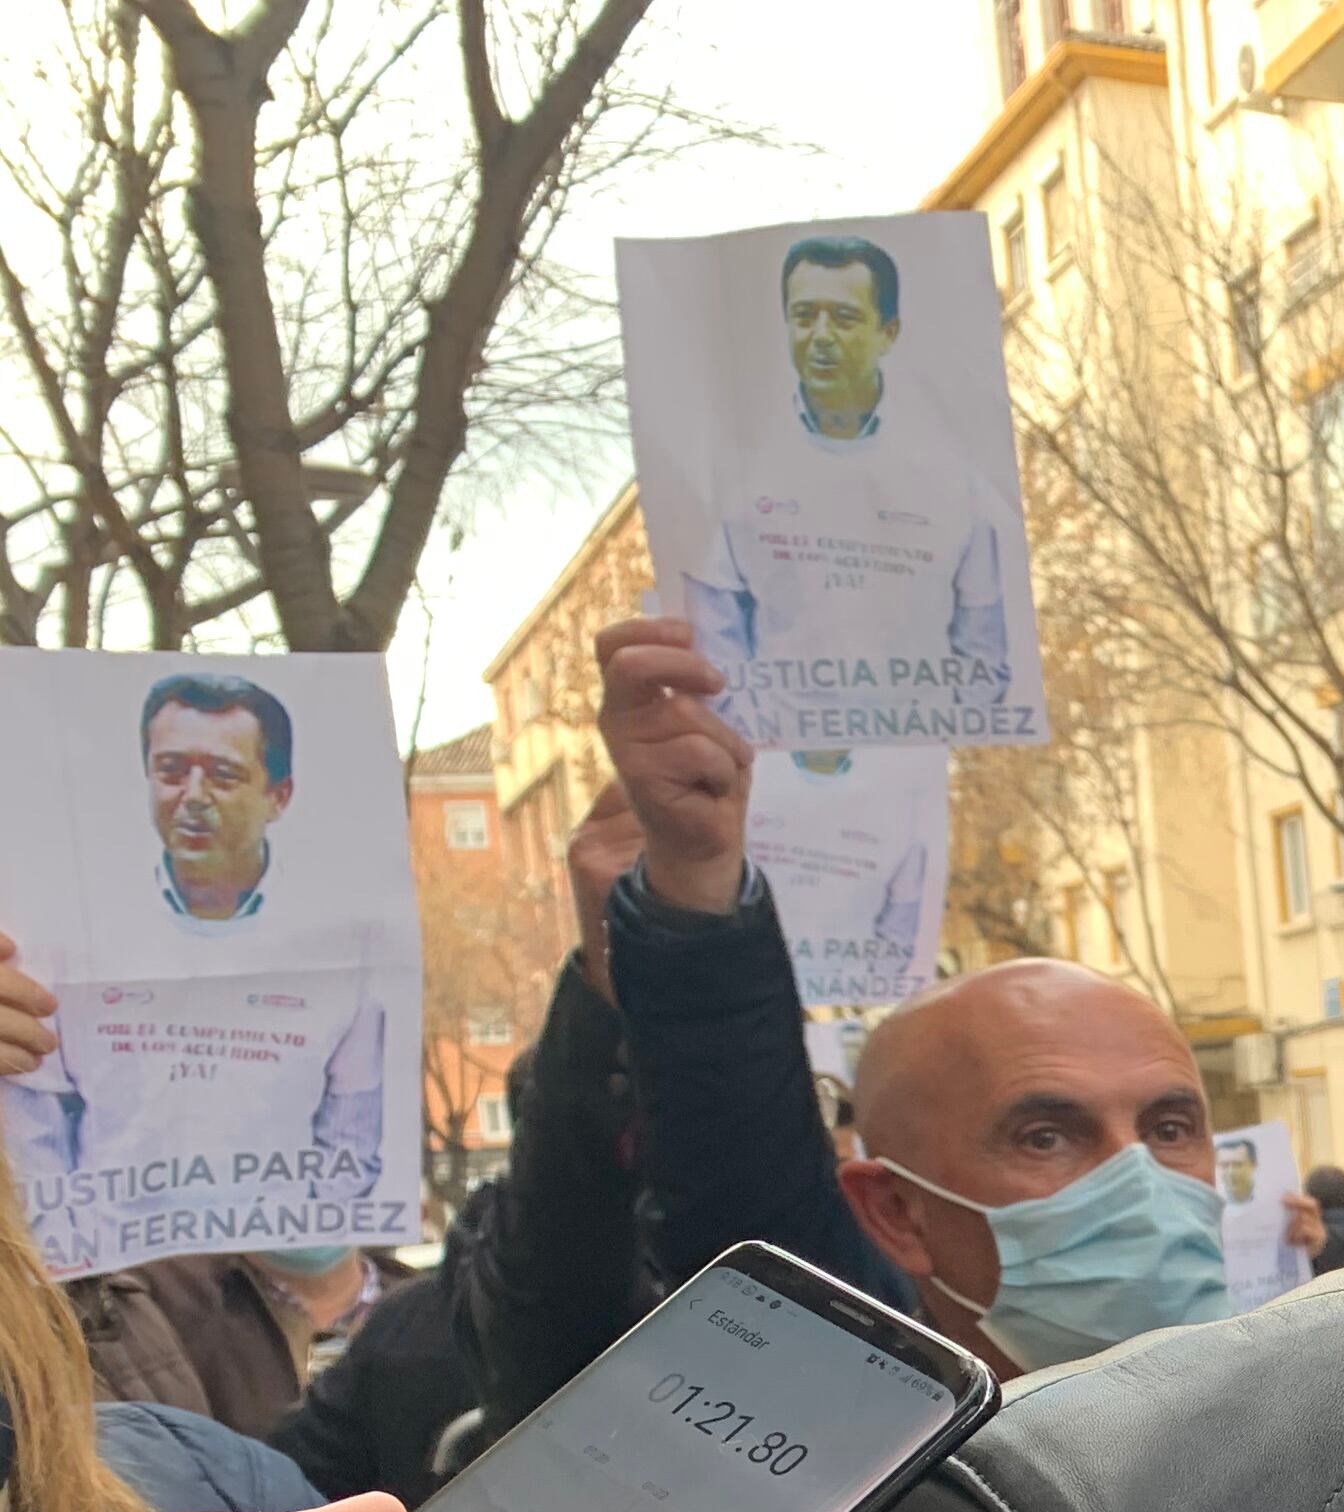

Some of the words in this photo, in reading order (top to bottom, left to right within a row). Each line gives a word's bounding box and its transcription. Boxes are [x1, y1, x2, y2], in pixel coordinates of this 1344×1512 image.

[727, 657, 877, 693] USTICIA
[888, 657, 997, 687] PARA
[799, 699, 1037, 738] FERNÁNDEZ
[824, 937, 902, 960] PARA
[231, 1148, 363, 1184] PARA
[119, 1196, 408, 1253] FERNÁNDEZ
[706, 1308, 771, 1350] Estándar
[648, 1372, 809, 1476] 01:21.80
